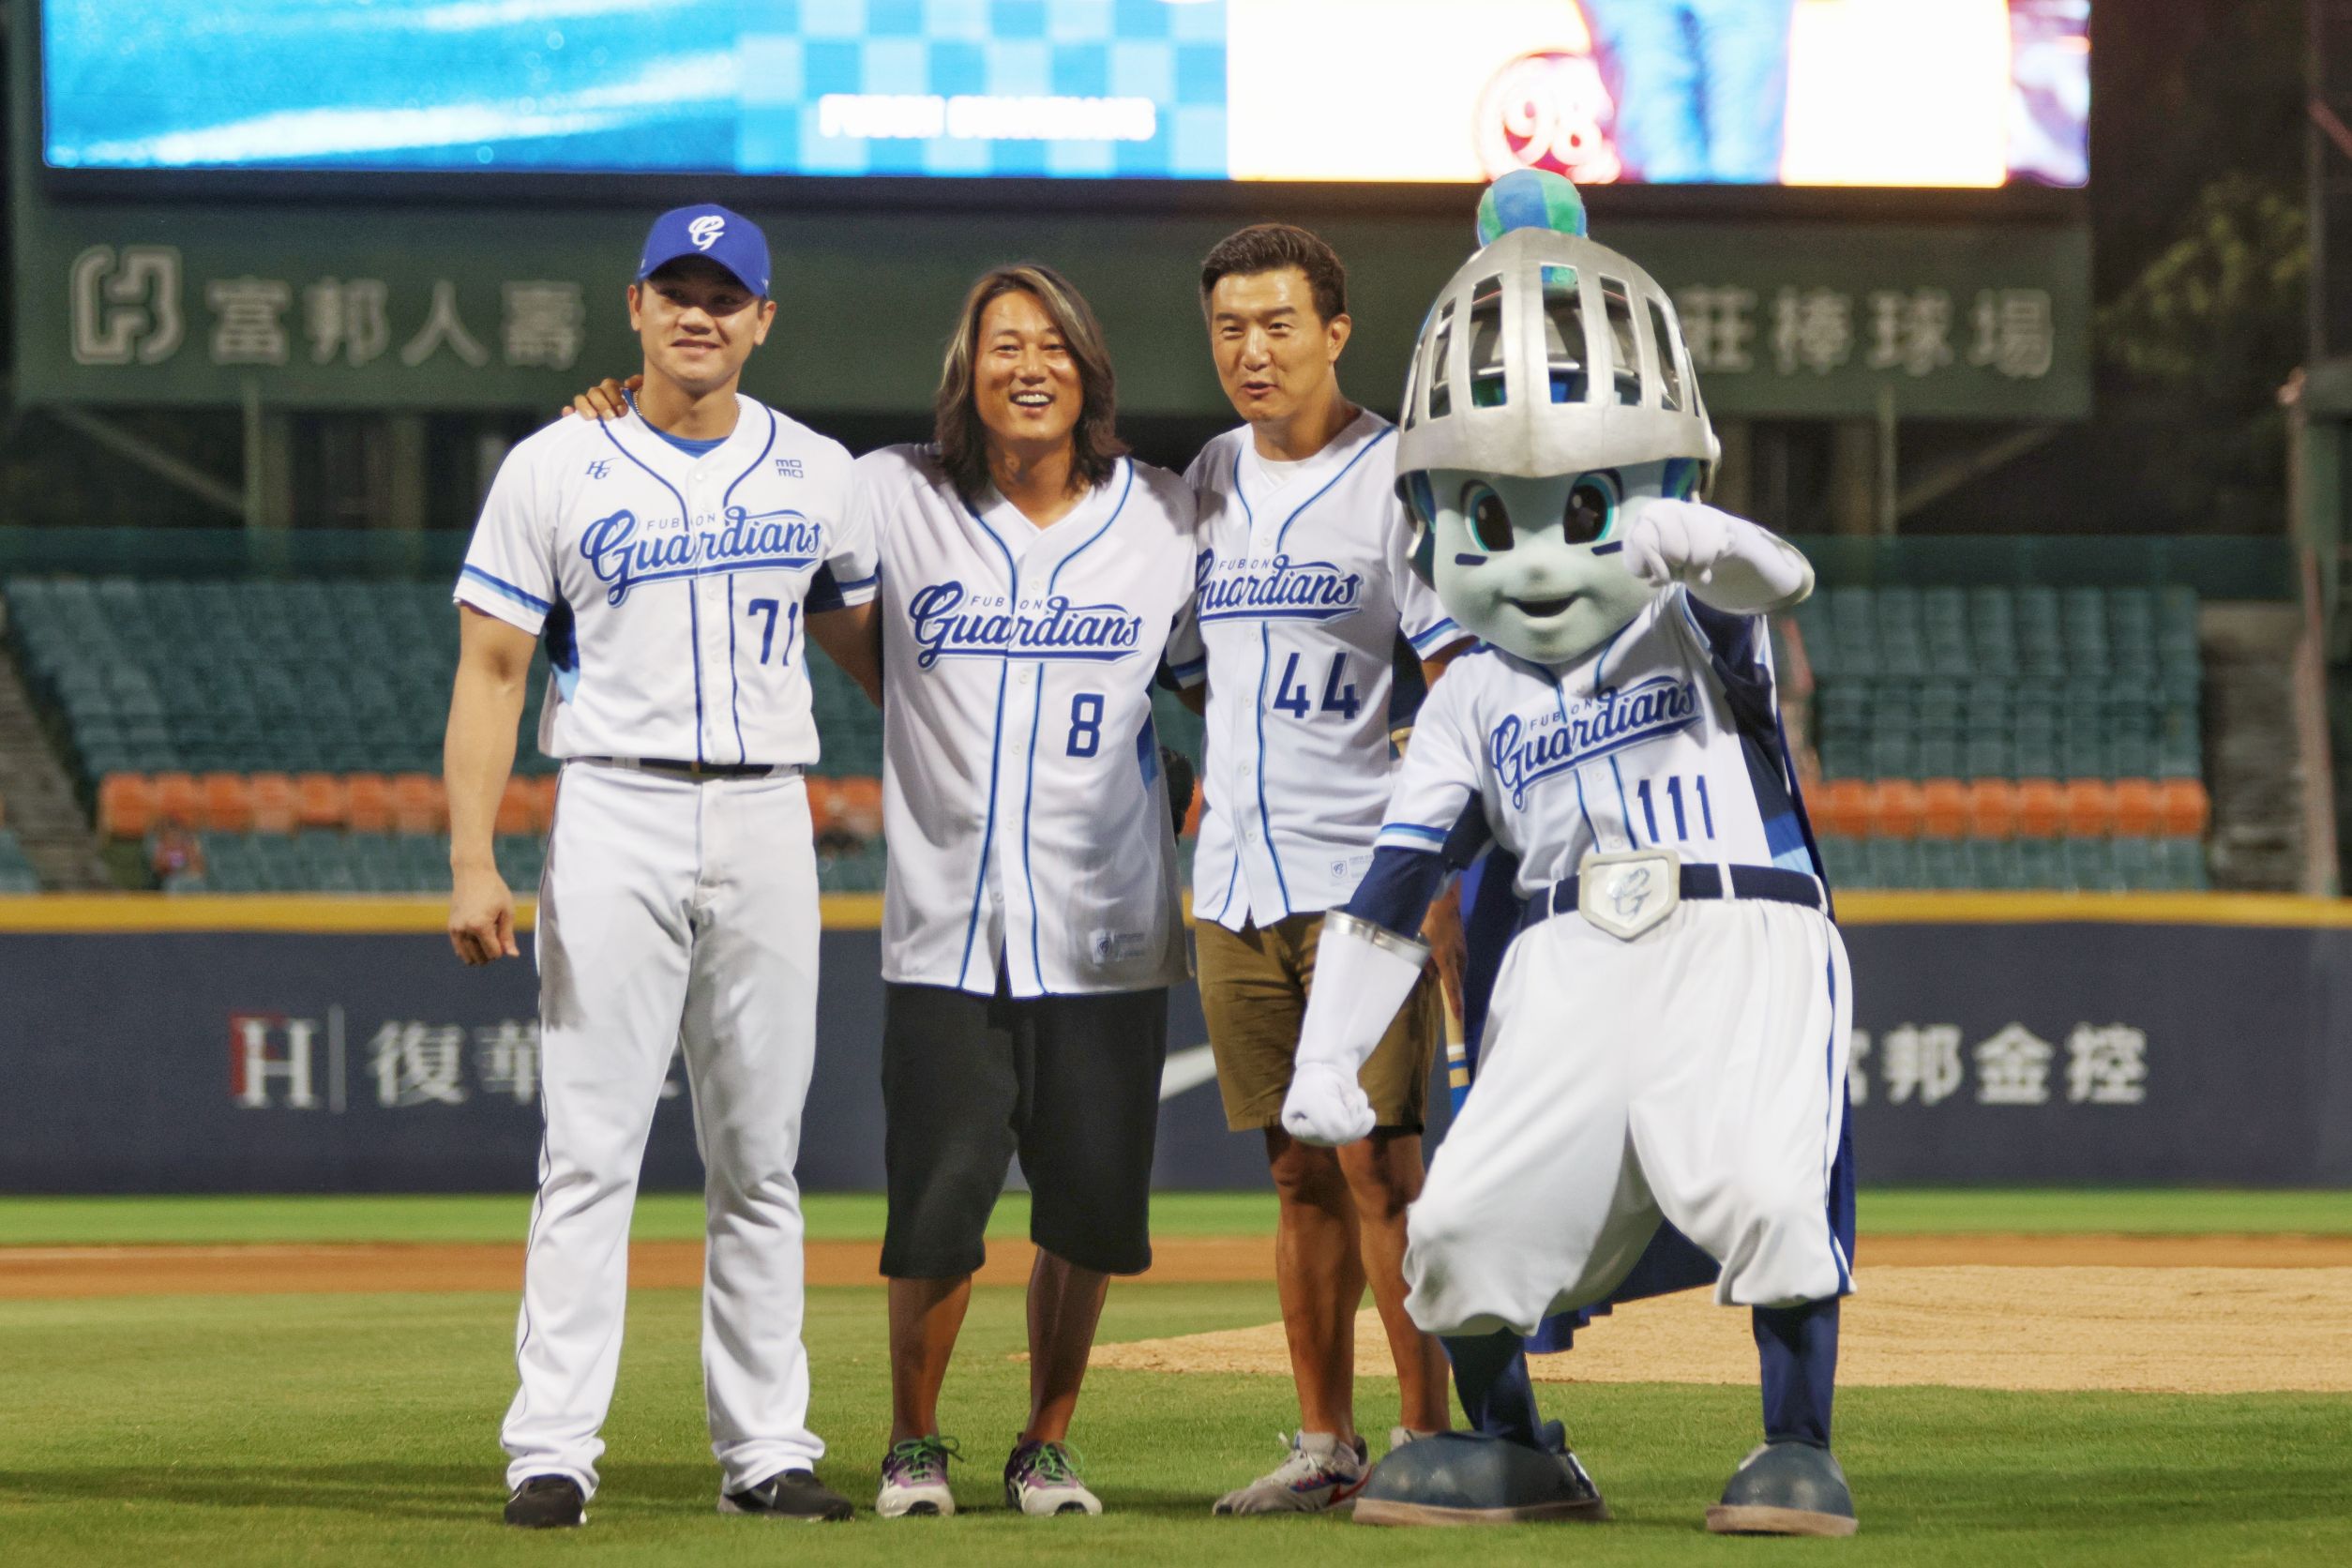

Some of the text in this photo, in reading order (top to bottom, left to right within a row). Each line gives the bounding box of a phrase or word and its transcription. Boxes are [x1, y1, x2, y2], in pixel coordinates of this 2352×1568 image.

[205, 276, 586, 369] 富邦人壽
[646, 512, 716, 531] FUBON
[580, 506, 822, 607] Guardians
[1218, 558, 1270, 571] FUBON
[747, 598, 799, 667] 71
[909, 580, 1142, 669] Guardians
[971, 596, 1043, 610] FUBON
[1273, 652, 1361, 720] 44
[1529, 700, 1592, 730] FUBON
[1065, 692, 1105, 759] 8
[1489, 674, 1702, 810] Guardians
[1637, 774, 1715, 843] 111
[1851, 1021, 2148, 1106] 邦金控
